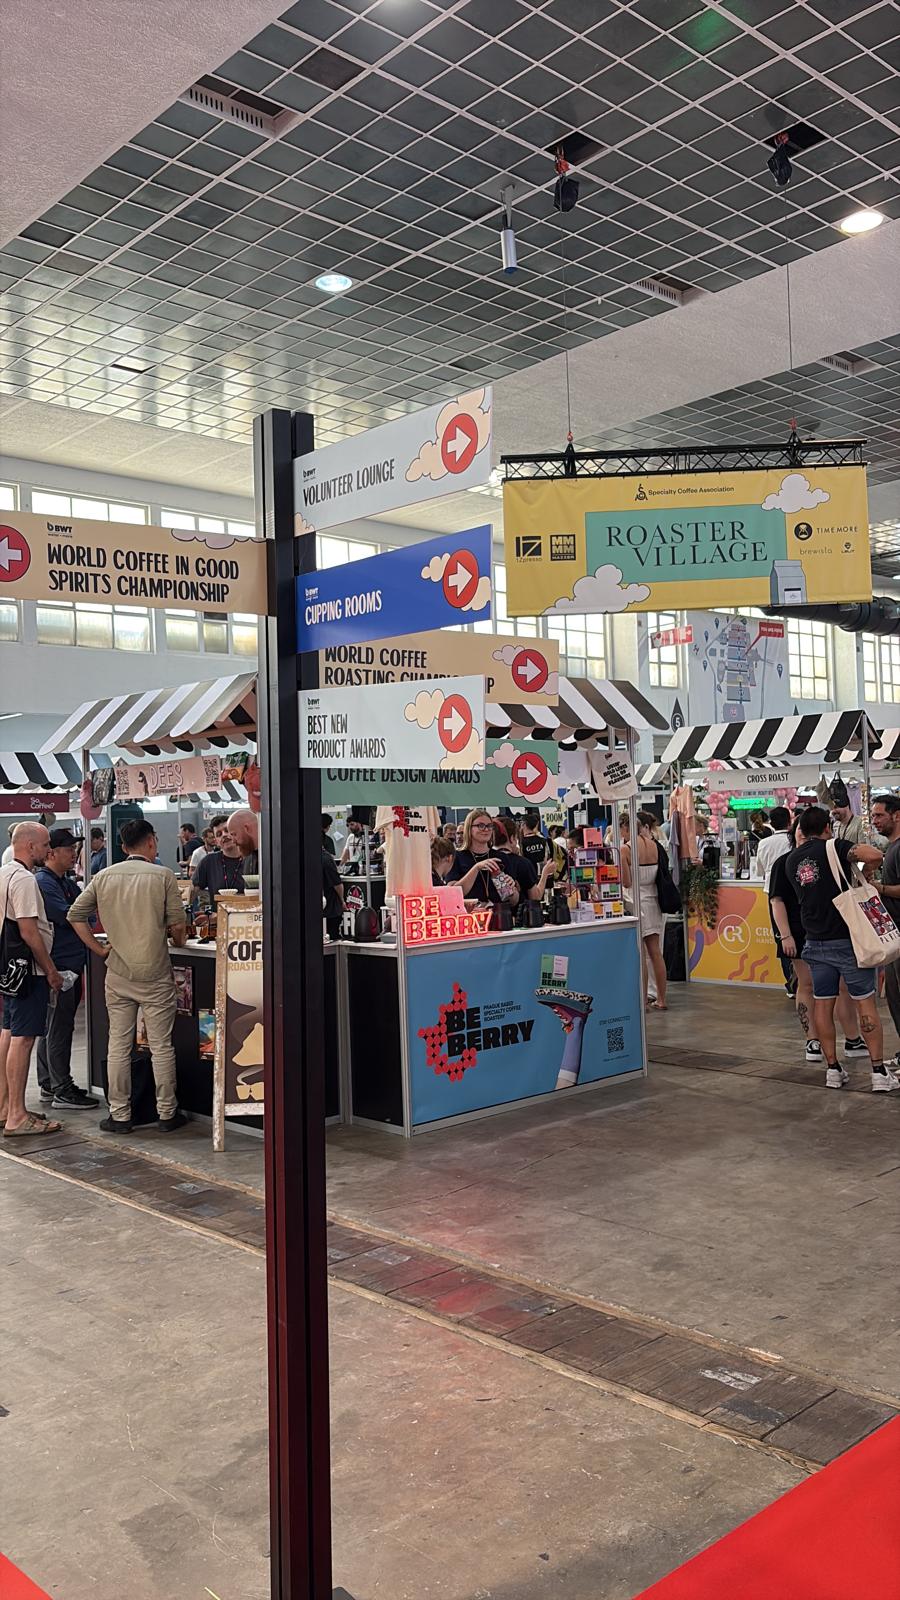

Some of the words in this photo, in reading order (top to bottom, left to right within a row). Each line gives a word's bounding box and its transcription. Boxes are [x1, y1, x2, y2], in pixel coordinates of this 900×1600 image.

[303, 473, 353, 507] VOLUNTEER
[357, 459, 395, 490] LOUNGE
[648, 488, 676, 496] Specialty
[55, 525, 72, 534] BWT
[606, 520, 749, 547] ROASTER
[48, 543, 106, 568] WORLD
[113, 550, 169, 574] COFFEE
[176, 555, 189, 576] IN
[196, 558, 239, 580] GOOD
[632, 541, 768, 567] VILLAGE
[48, 570, 112, 594] SPIRITS
[117, 576, 230, 602] CHAMPIONSHIP
[305, 600, 342, 626] CUPPING
[345, 590, 382, 618] ROOMS
[325, 646, 374, 665] WORLD
[380, 648, 428, 668] COFFEE
[324, 666, 396, 686] ROASTING
[308, 715, 328, 735] BEST
[331, 714, 348, 734] NEW
[308, 738, 346, 758] PRODUCT
[350, 738, 386, 758] AWARDS
[150, 762, 184, 789] DEES
[327, 768, 376, 782] COFFEE
[381, 769, 426, 783] DESIGN
[430, 770, 480, 784] AWARDS
[746, 774, 767, 784] CROSS
[768, 773, 789, 782] ROAST
[254, 914, 262, 922] DE
[404, 895, 440, 920] BE
[228, 926, 262, 940] SPECI
[405, 912, 492, 943] BERRY
[228, 940, 263, 962] COF
[228, 962, 262, 972] ROASTE
[446, 1006, 481, 1033] BE
[447, 1020, 535, 1057] BERRY
